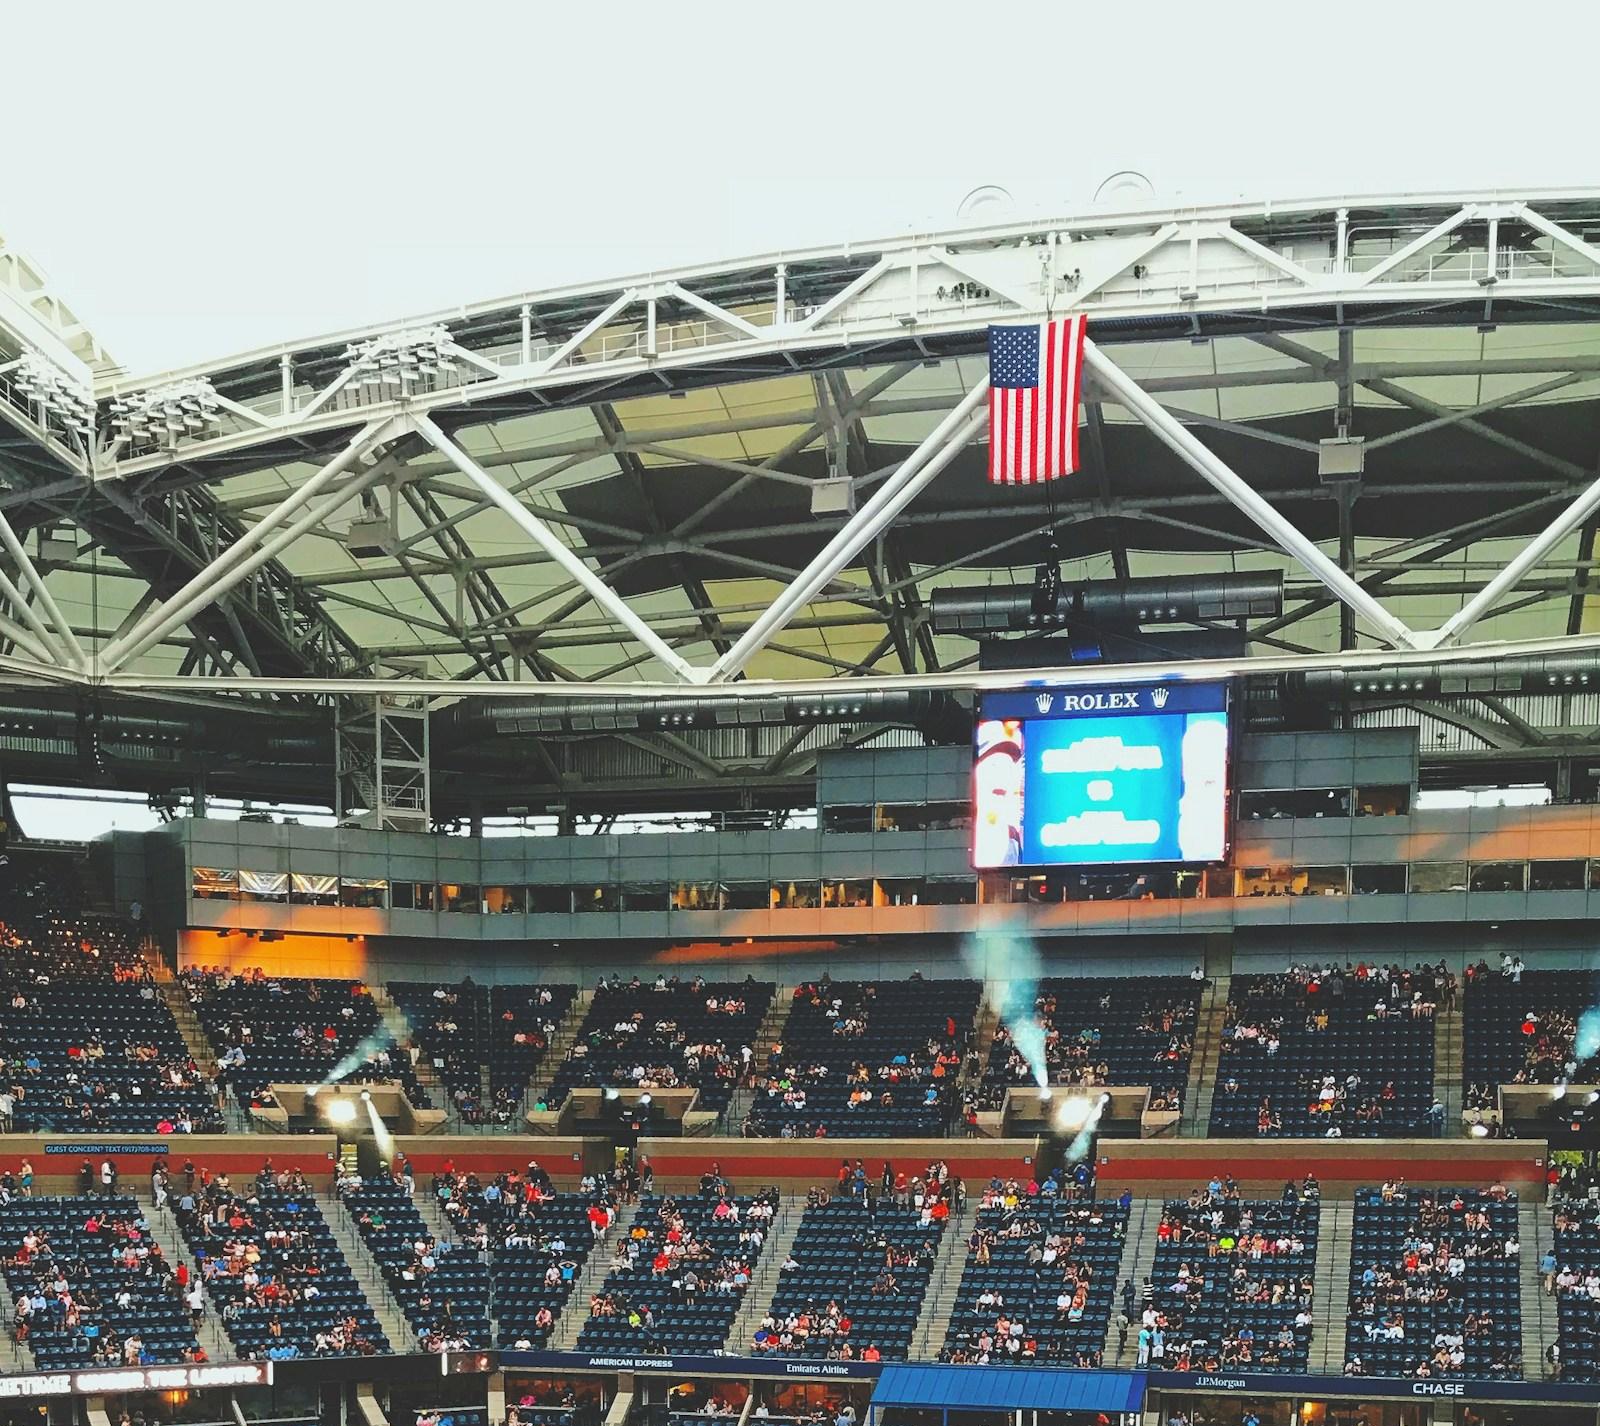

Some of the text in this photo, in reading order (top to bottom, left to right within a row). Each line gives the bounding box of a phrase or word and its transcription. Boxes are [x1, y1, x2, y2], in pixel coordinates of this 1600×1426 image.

[1063, 692, 1140, 711] ROLEX
[589, 1358, 673, 1368] AMERICAN EXPRESS
[786, 1363, 849, 1375] Emirates Airline
[1195, 1376, 1246, 1389] J.P.Morgan
[1412, 1383, 1465, 1395] CHASE
